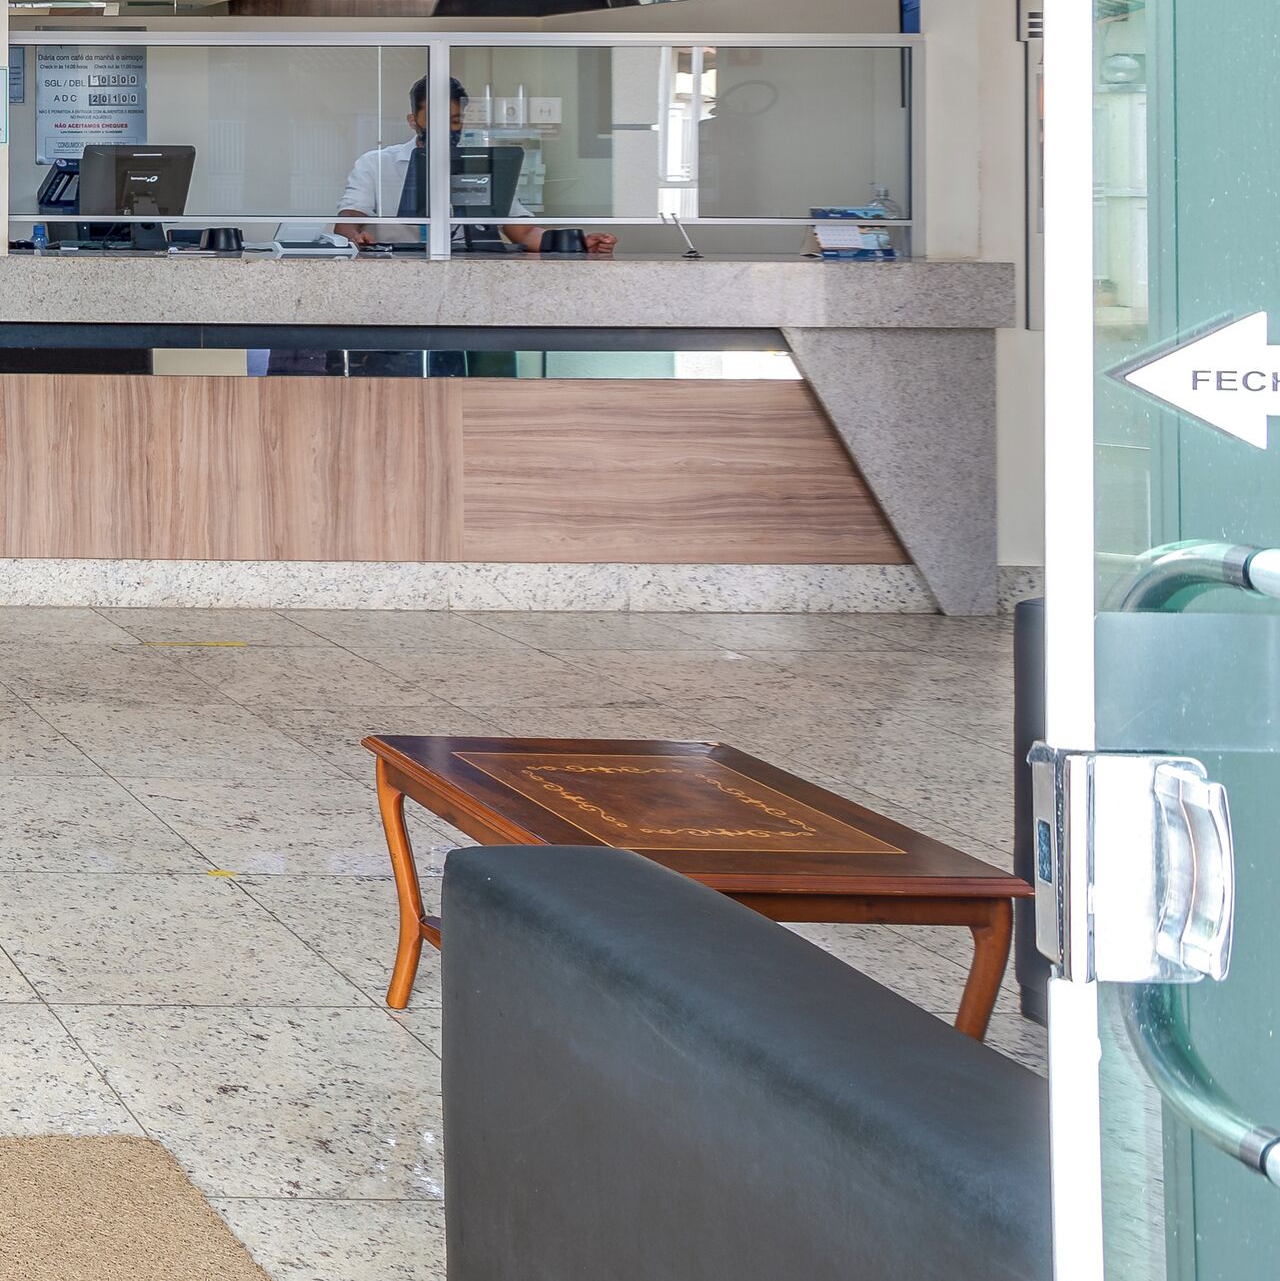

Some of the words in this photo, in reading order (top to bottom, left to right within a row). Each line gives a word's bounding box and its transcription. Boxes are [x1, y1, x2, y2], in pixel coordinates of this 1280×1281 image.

[121, 54, 144, 62] almoço
[45, 79, 62, 87] SGL
[69, 79, 87, 87] DBL
